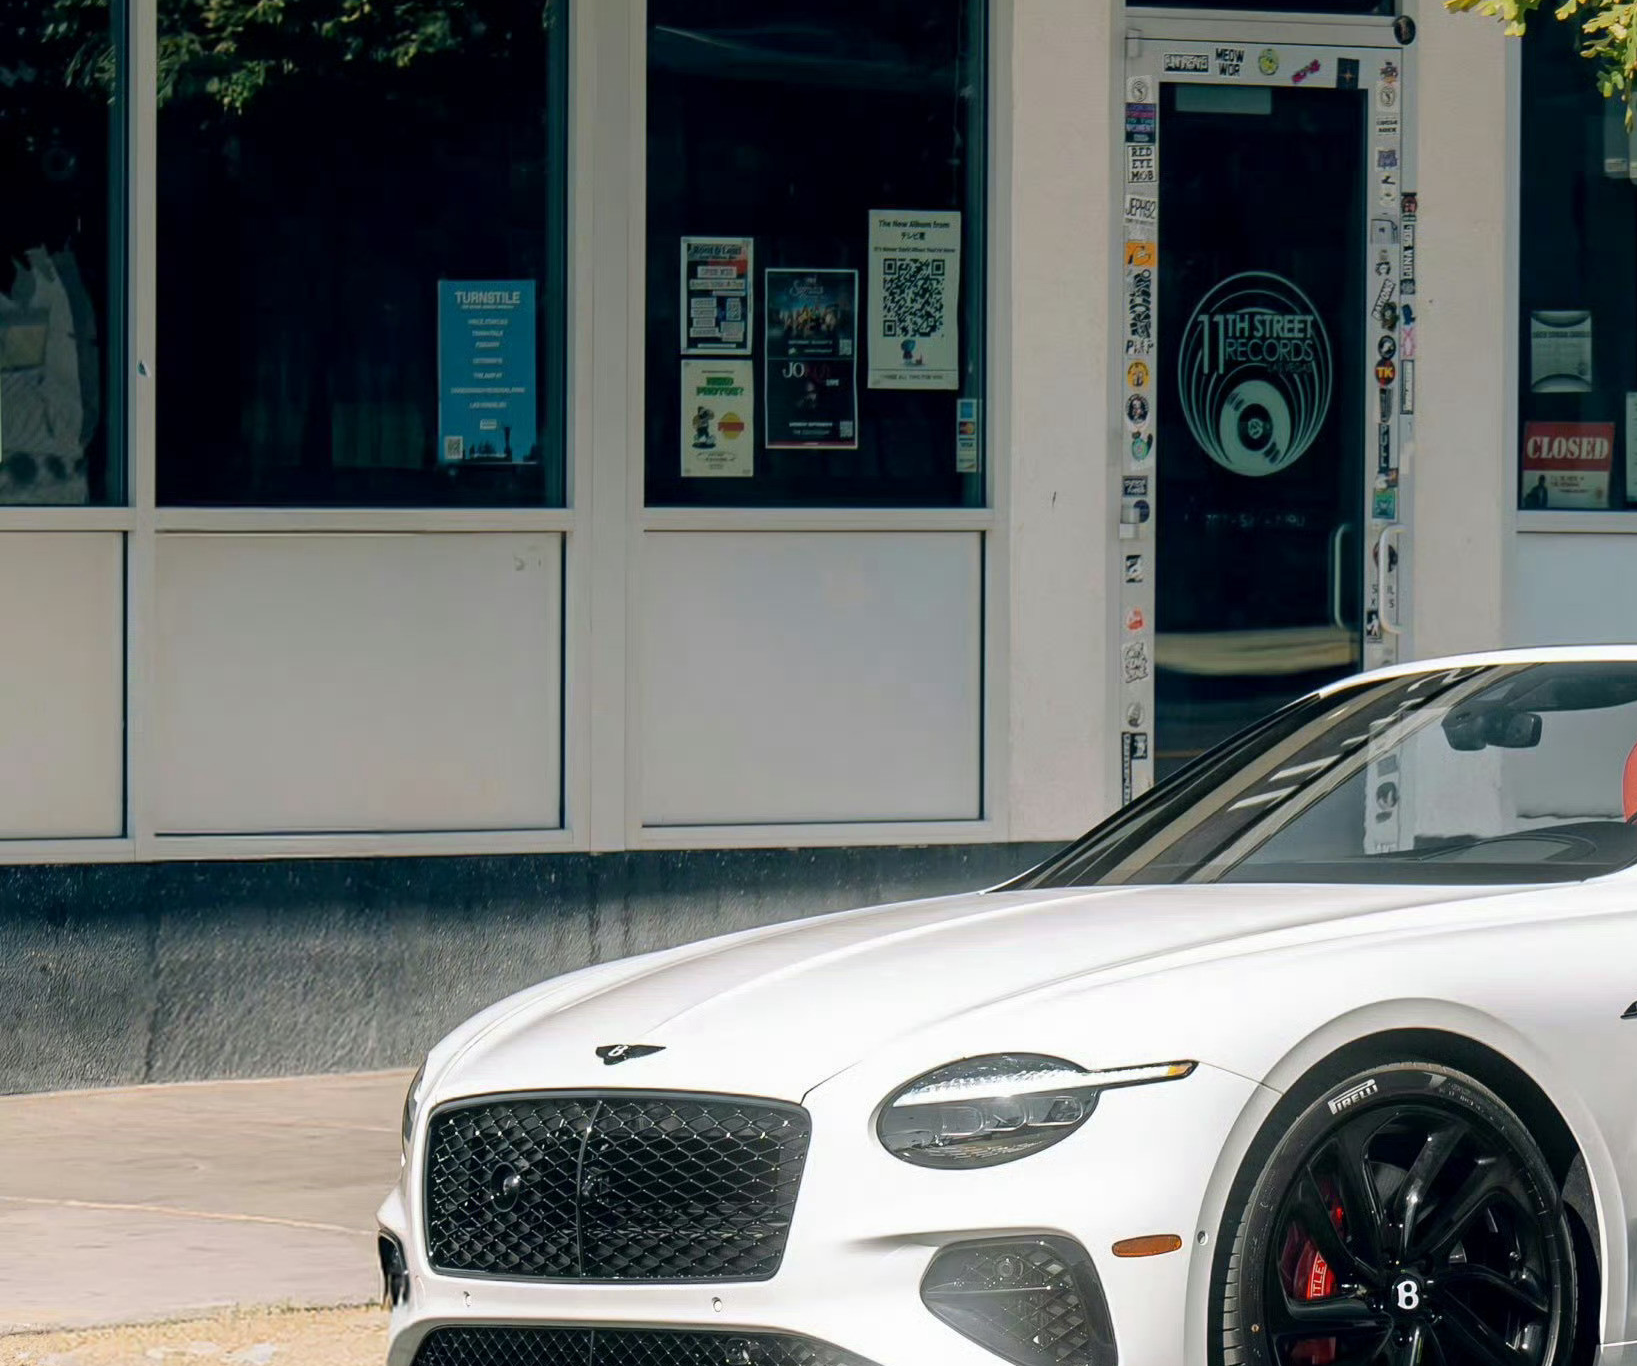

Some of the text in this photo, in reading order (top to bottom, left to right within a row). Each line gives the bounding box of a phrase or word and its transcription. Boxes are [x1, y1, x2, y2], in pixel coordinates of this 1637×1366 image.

[1215, 48, 1245, 63] MEOW
[1131, 147, 1153, 158] RED
[1131, 158, 1153, 169] EYE
[1131, 170, 1154, 181] MOB
[879, 220, 891, 228] The
[893, 220, 908, 228] New
[455, 291, 521, 305] TURNSTILE
[1254, 314, 1315, 338] STREET
[1225, 338, 1314, 362] RECORDS
[1526, 436, 1609, 460] CLOSED
[1327, 1078, 1378, 1115] PIRELLI
[1396, 1280, 1420, 1310] B
